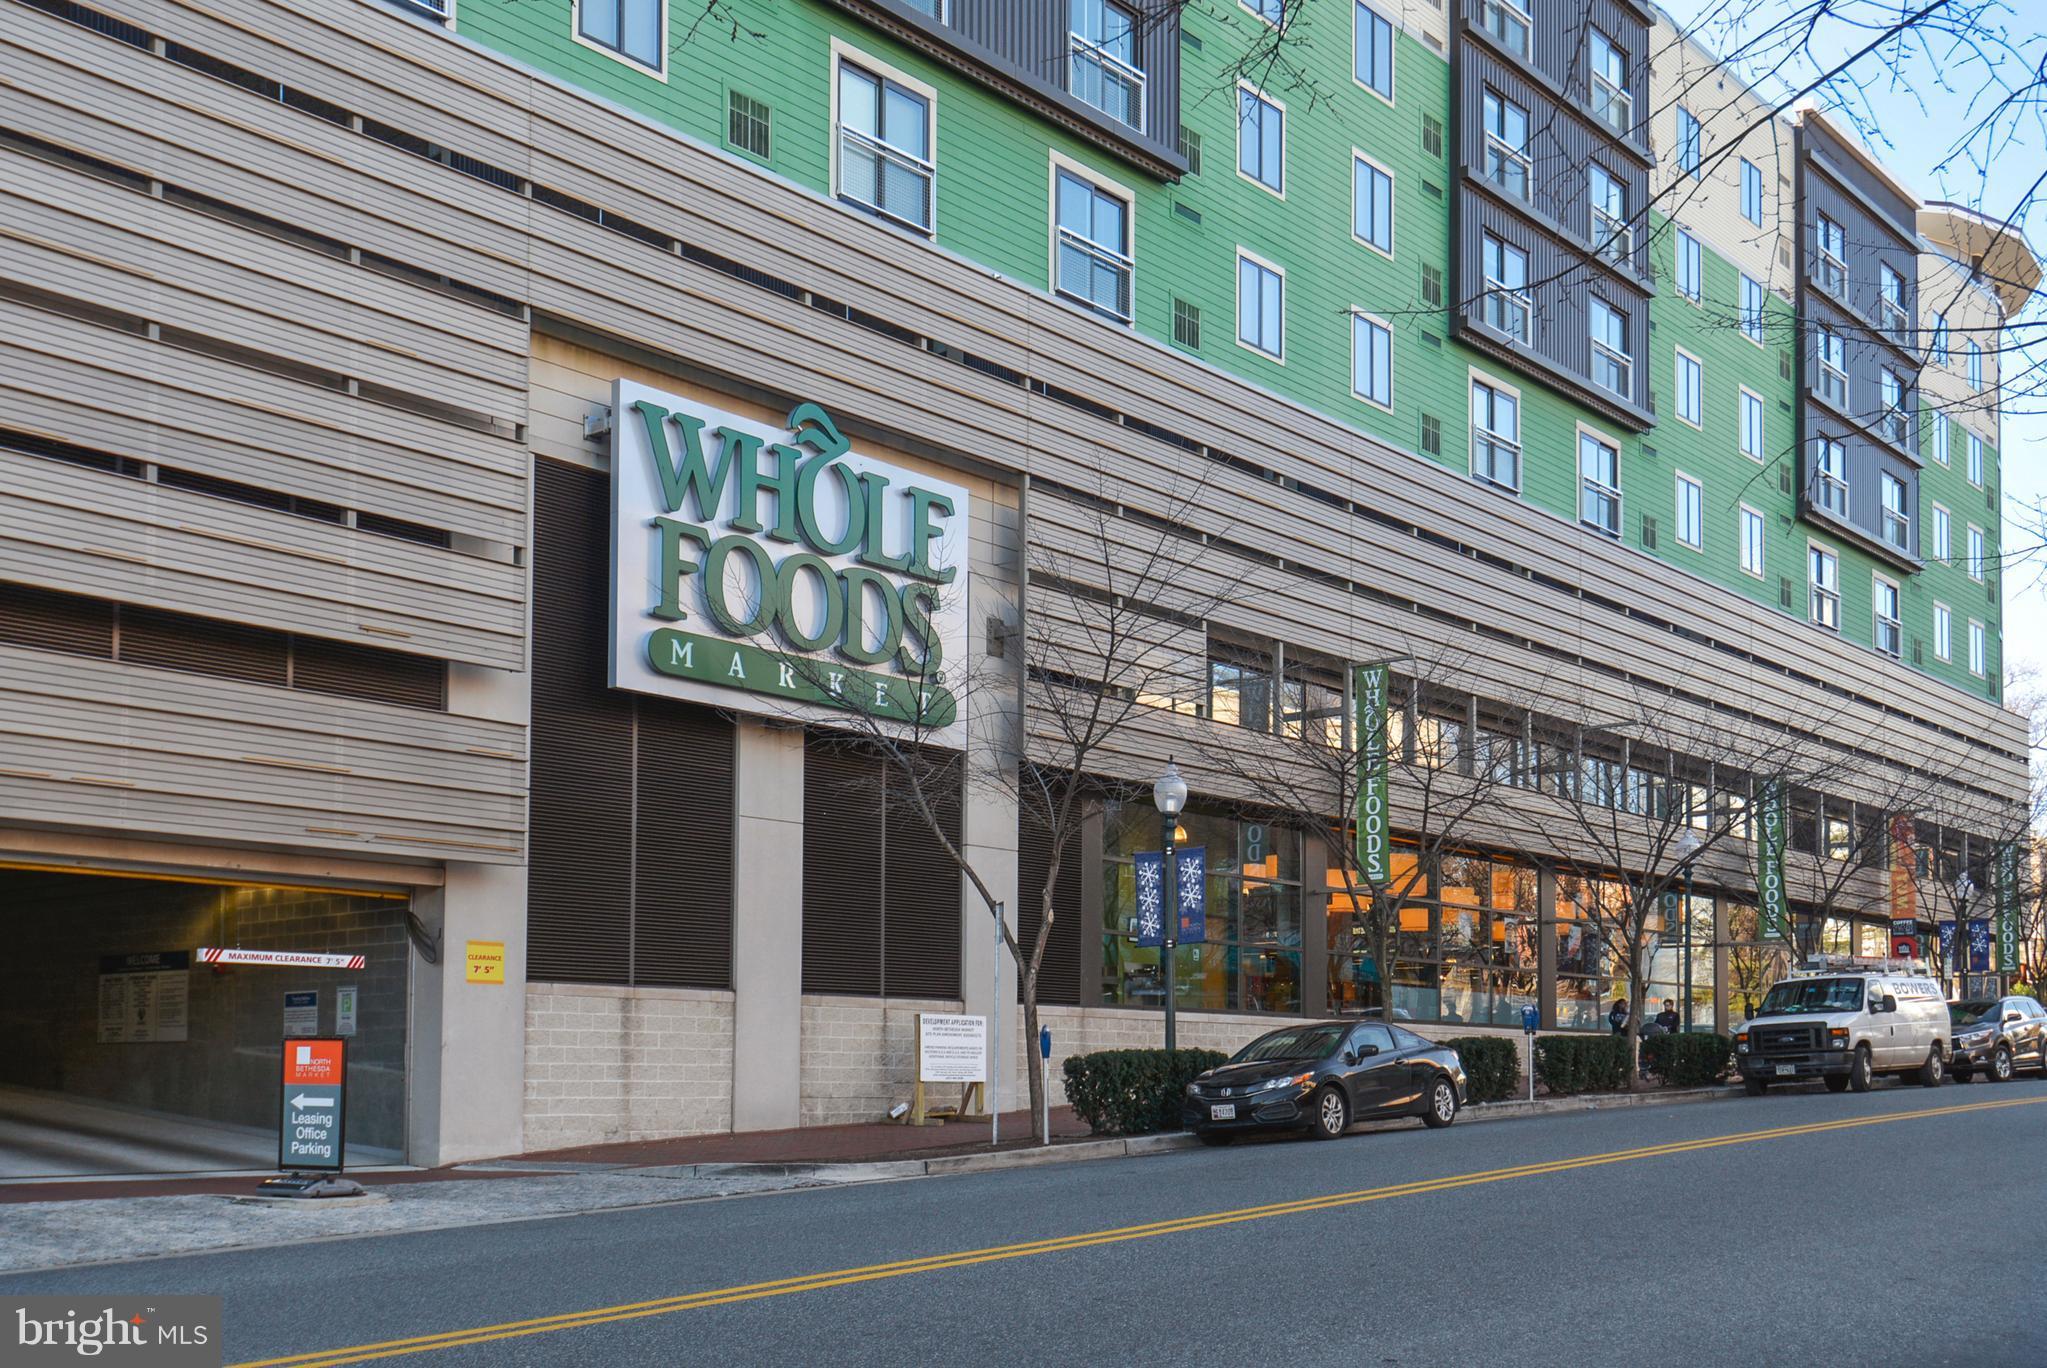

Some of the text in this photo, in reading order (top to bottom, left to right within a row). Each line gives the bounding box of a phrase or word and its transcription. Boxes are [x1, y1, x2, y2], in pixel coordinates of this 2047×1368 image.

[635, 400, 956, 584] WHOLE
[651, 516, 942, 676] FOODS
[670, 639, 932, 716] MARKET
[1762, 780, 1780, 857] WOLE
[228, 952, 273, 962] MAXIMUM
[275, 954, 322, 964] CLEARANCE
[1892, 983, 1938, 995] BOWERS
[291, 1111, 333, 1128] Leasing
[296, 1127, 327, 1140] Office
[291, 1141, 331, 1158] Parking
